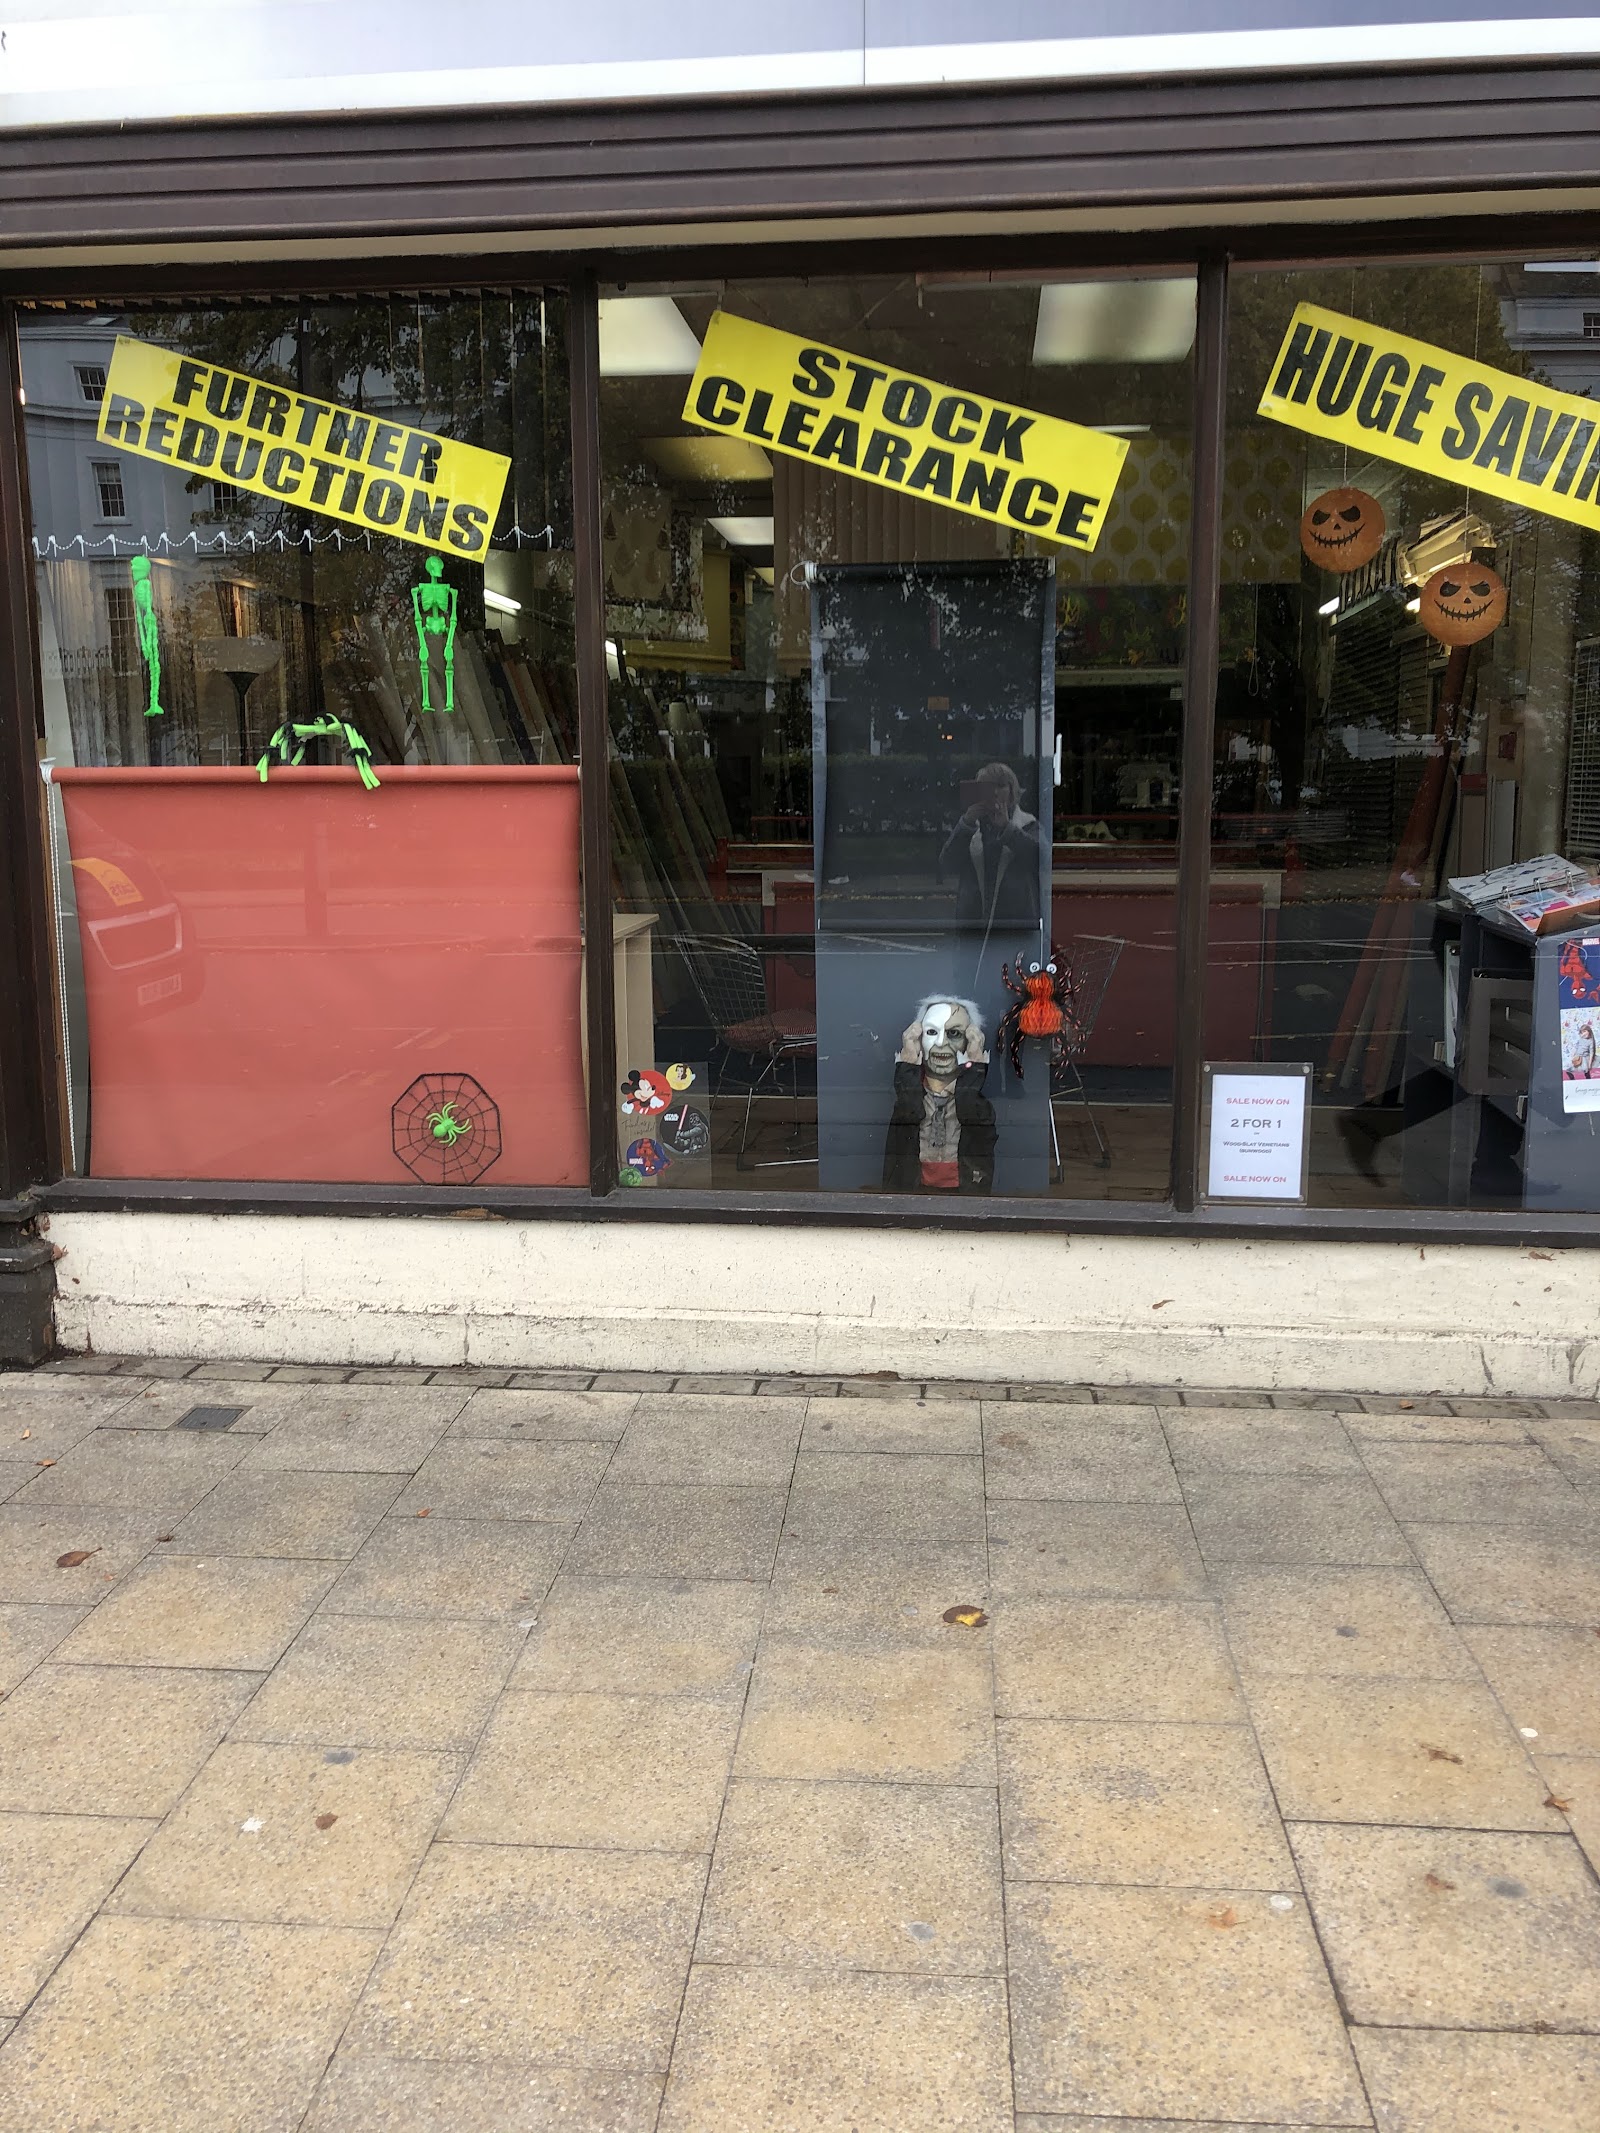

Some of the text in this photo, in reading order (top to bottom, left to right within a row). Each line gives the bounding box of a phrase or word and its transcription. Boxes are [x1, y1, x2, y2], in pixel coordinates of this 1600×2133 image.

[172, 359, 442, 484] FURTHER
[792, 347, 1037, 464] STOCK
[1271, 322, 1446, 446] HUGE
[104, 392, 488, 550] REDUCTIONS
[695, 375, 1100, 543] CLEARANCE
[1226, 1097, 1249, 1105] SALE
[1231, 1118, 1282, 1128] 2 FOR 1
